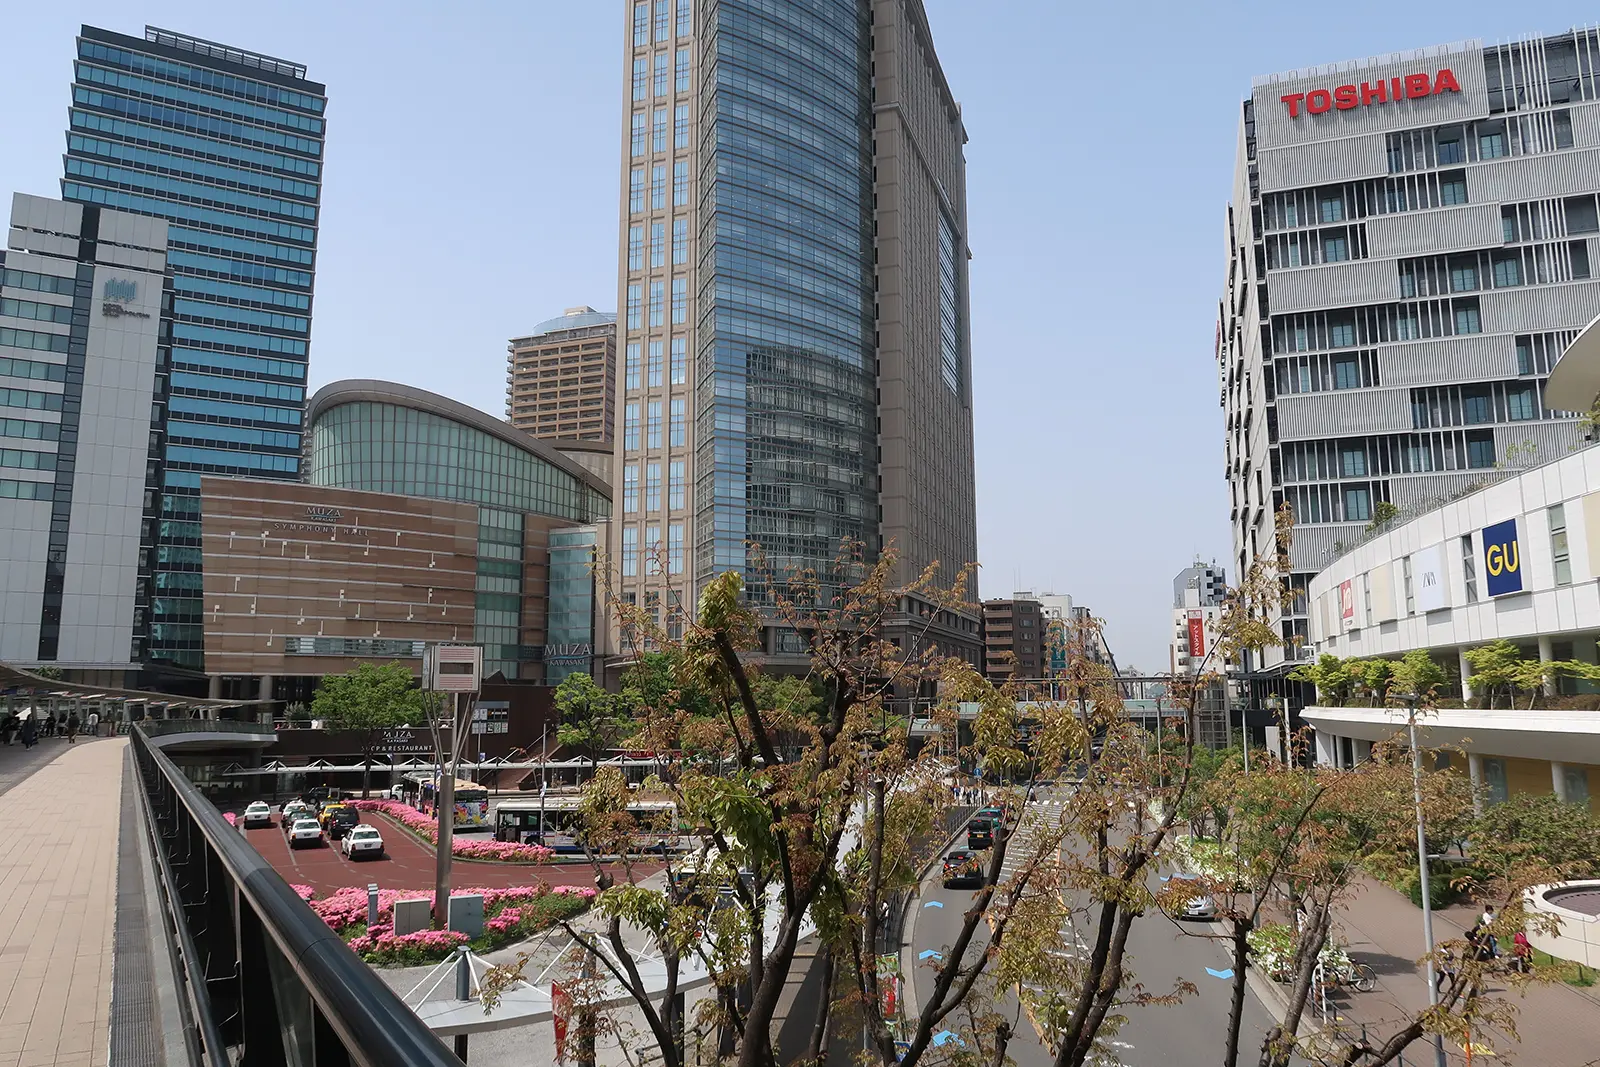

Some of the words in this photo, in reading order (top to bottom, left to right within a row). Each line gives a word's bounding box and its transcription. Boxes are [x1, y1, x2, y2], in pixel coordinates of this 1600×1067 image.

[1281, 69, 1461, 118] TOSHIBA
[306, 507, 341, 517] MUZA
[274, 523, 336, 533] SYMPHONY
[343, 528, 369, 537] HALL
[1486, 540, 1519, 577] GU
[544, 643, 591, 656] MUZA
[549, 659, 585, 667] KAWASAKI
